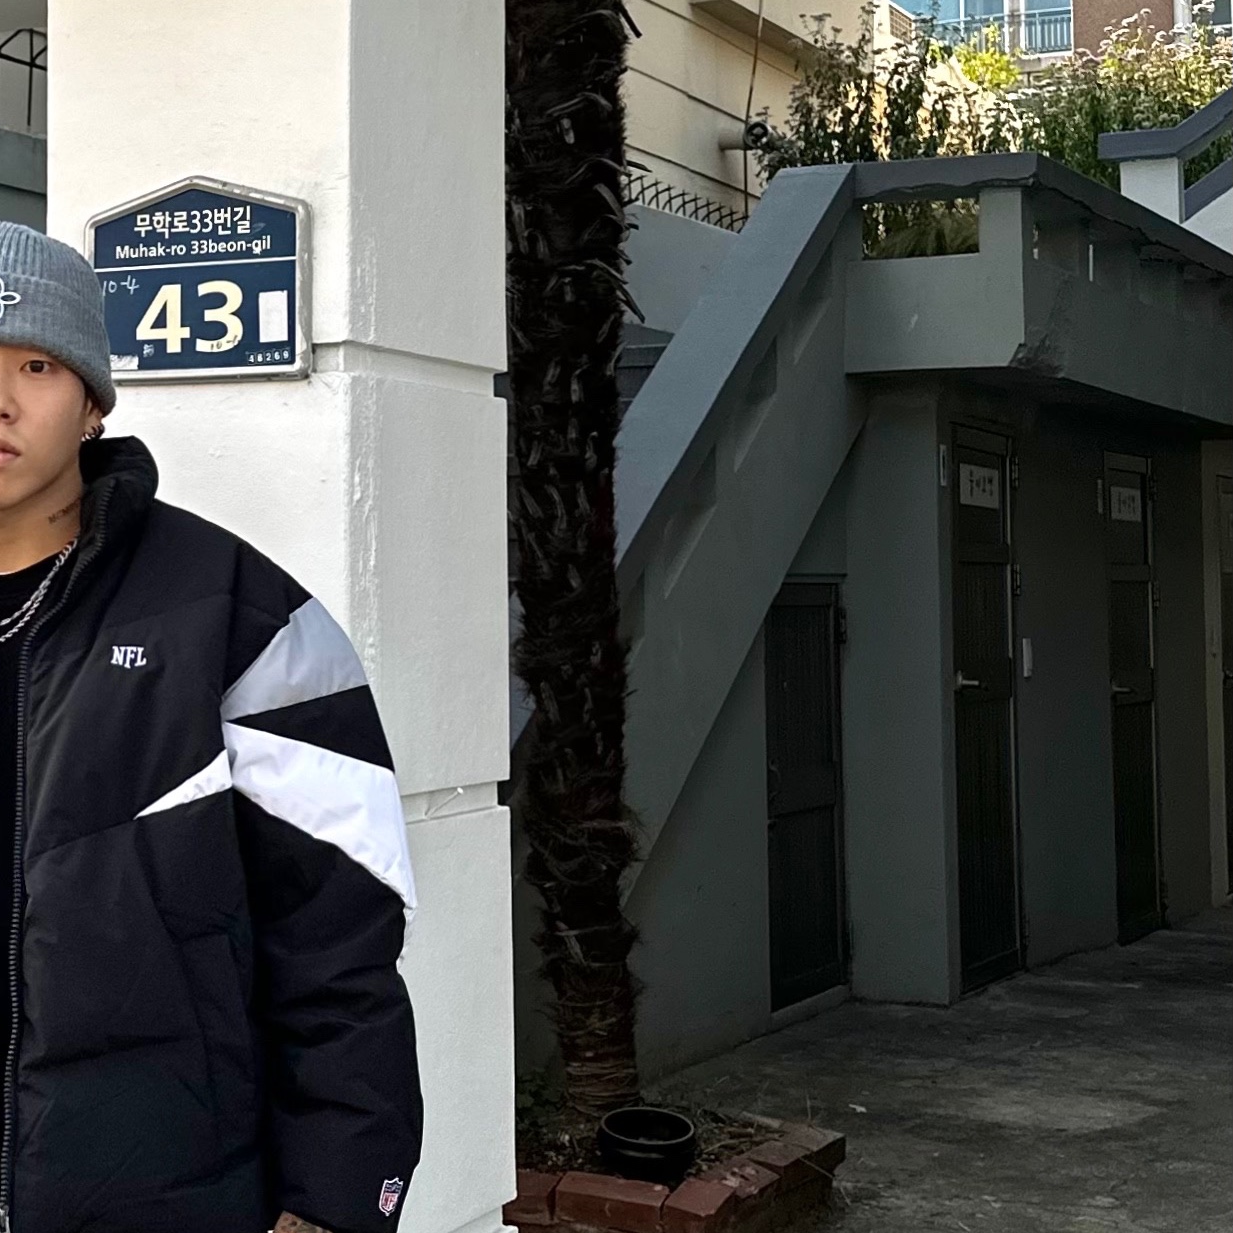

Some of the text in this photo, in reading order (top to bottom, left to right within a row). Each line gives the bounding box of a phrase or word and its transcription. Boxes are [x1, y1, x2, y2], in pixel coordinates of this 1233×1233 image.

[134, 205, 251, 239] 무학로33번길
[115, 235, 271, 260] Muhak-ro 33beon-gil
[136, 279, 244, 354] 43
[110, 645, 147, 669] NFL
